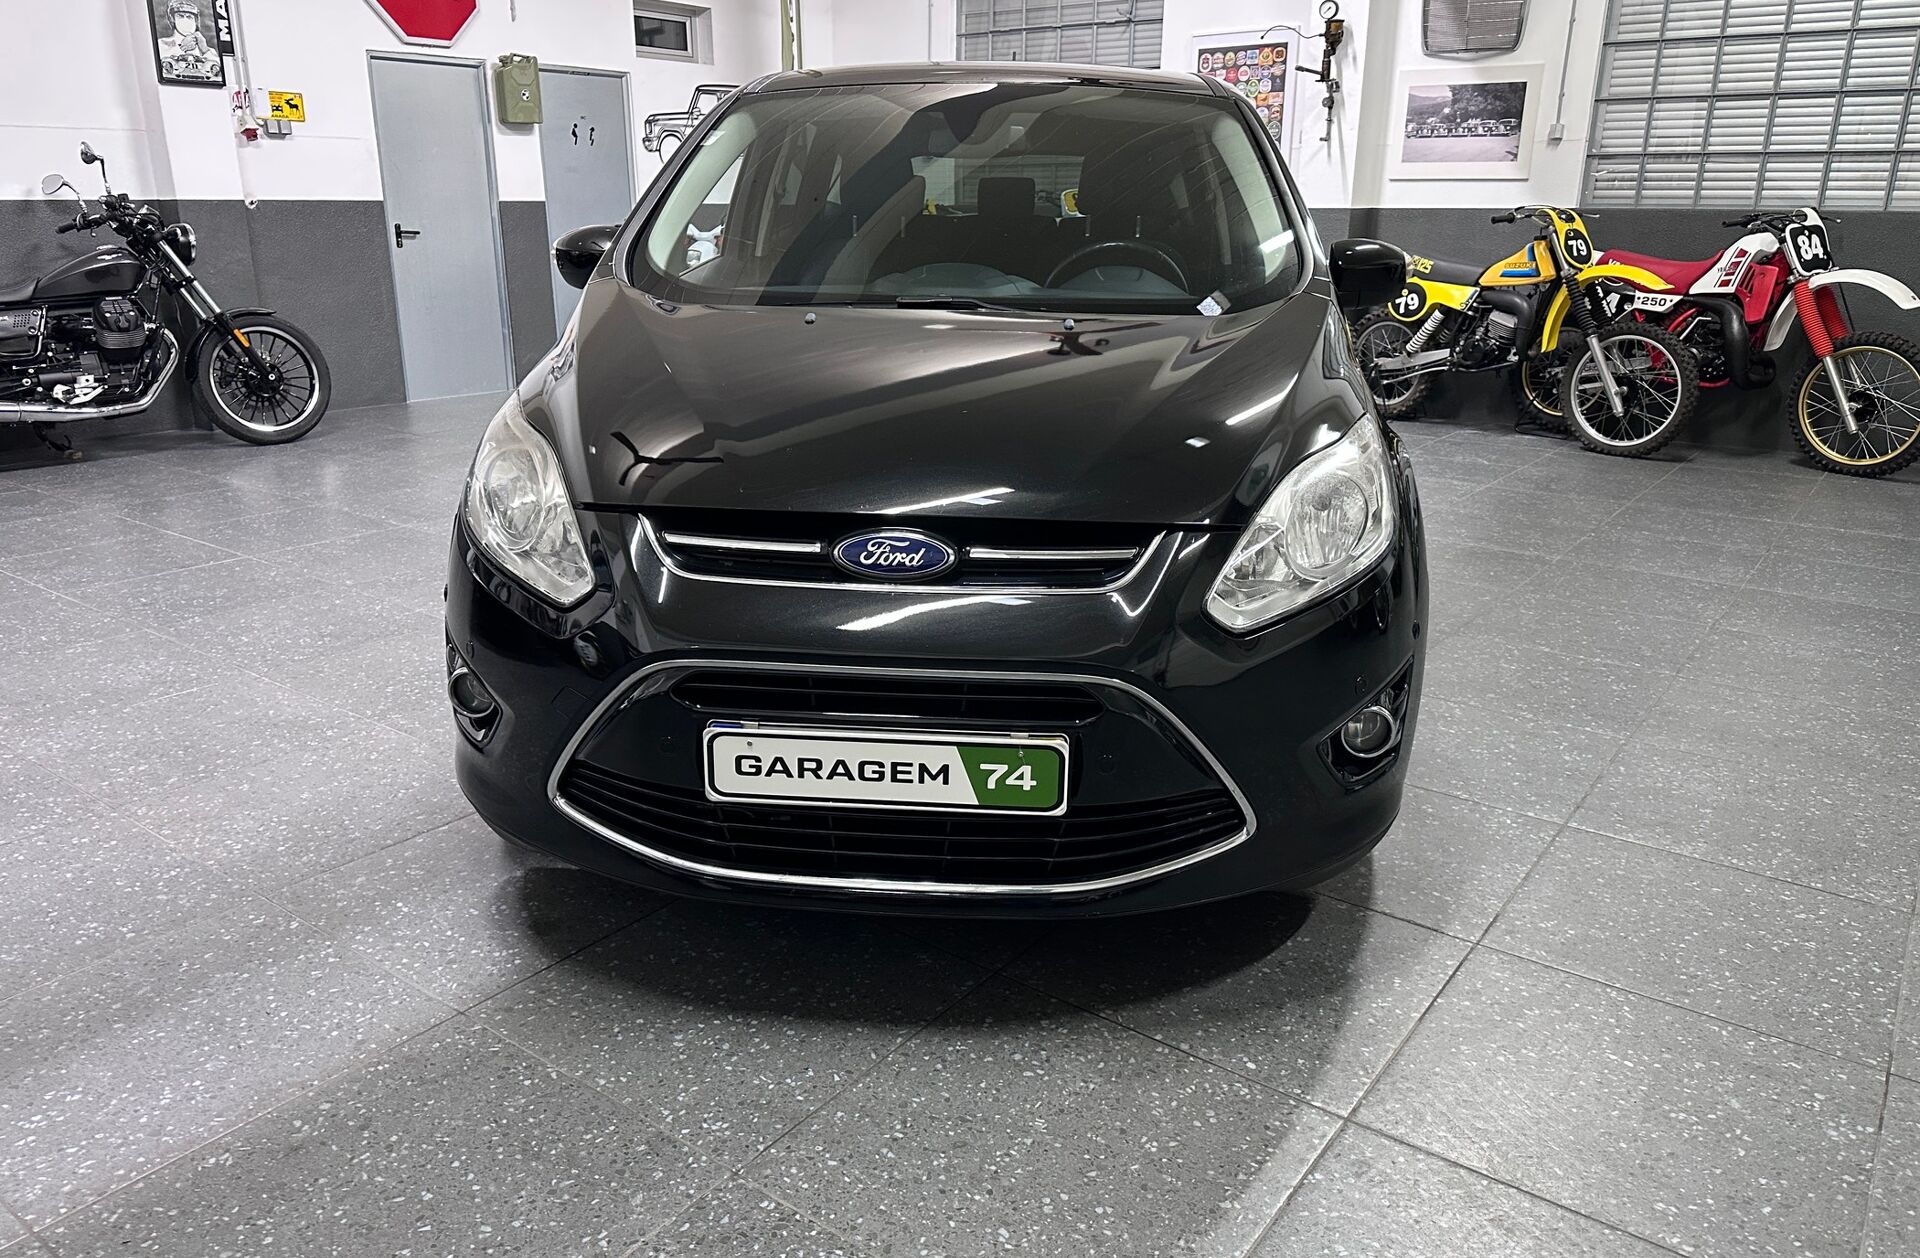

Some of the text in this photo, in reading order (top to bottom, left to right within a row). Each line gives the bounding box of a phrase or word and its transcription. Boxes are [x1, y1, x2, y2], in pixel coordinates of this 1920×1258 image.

[1567, 239, 1587, 256] 79
[1797, 234, 1824, 260] 84
[1395, 293, 1419, 314] 79
[1641, 296, 1667, 306] 250
[859, 538, 926, 568] Ford
[734, 754, 1037, 791] GARAGEM 74
